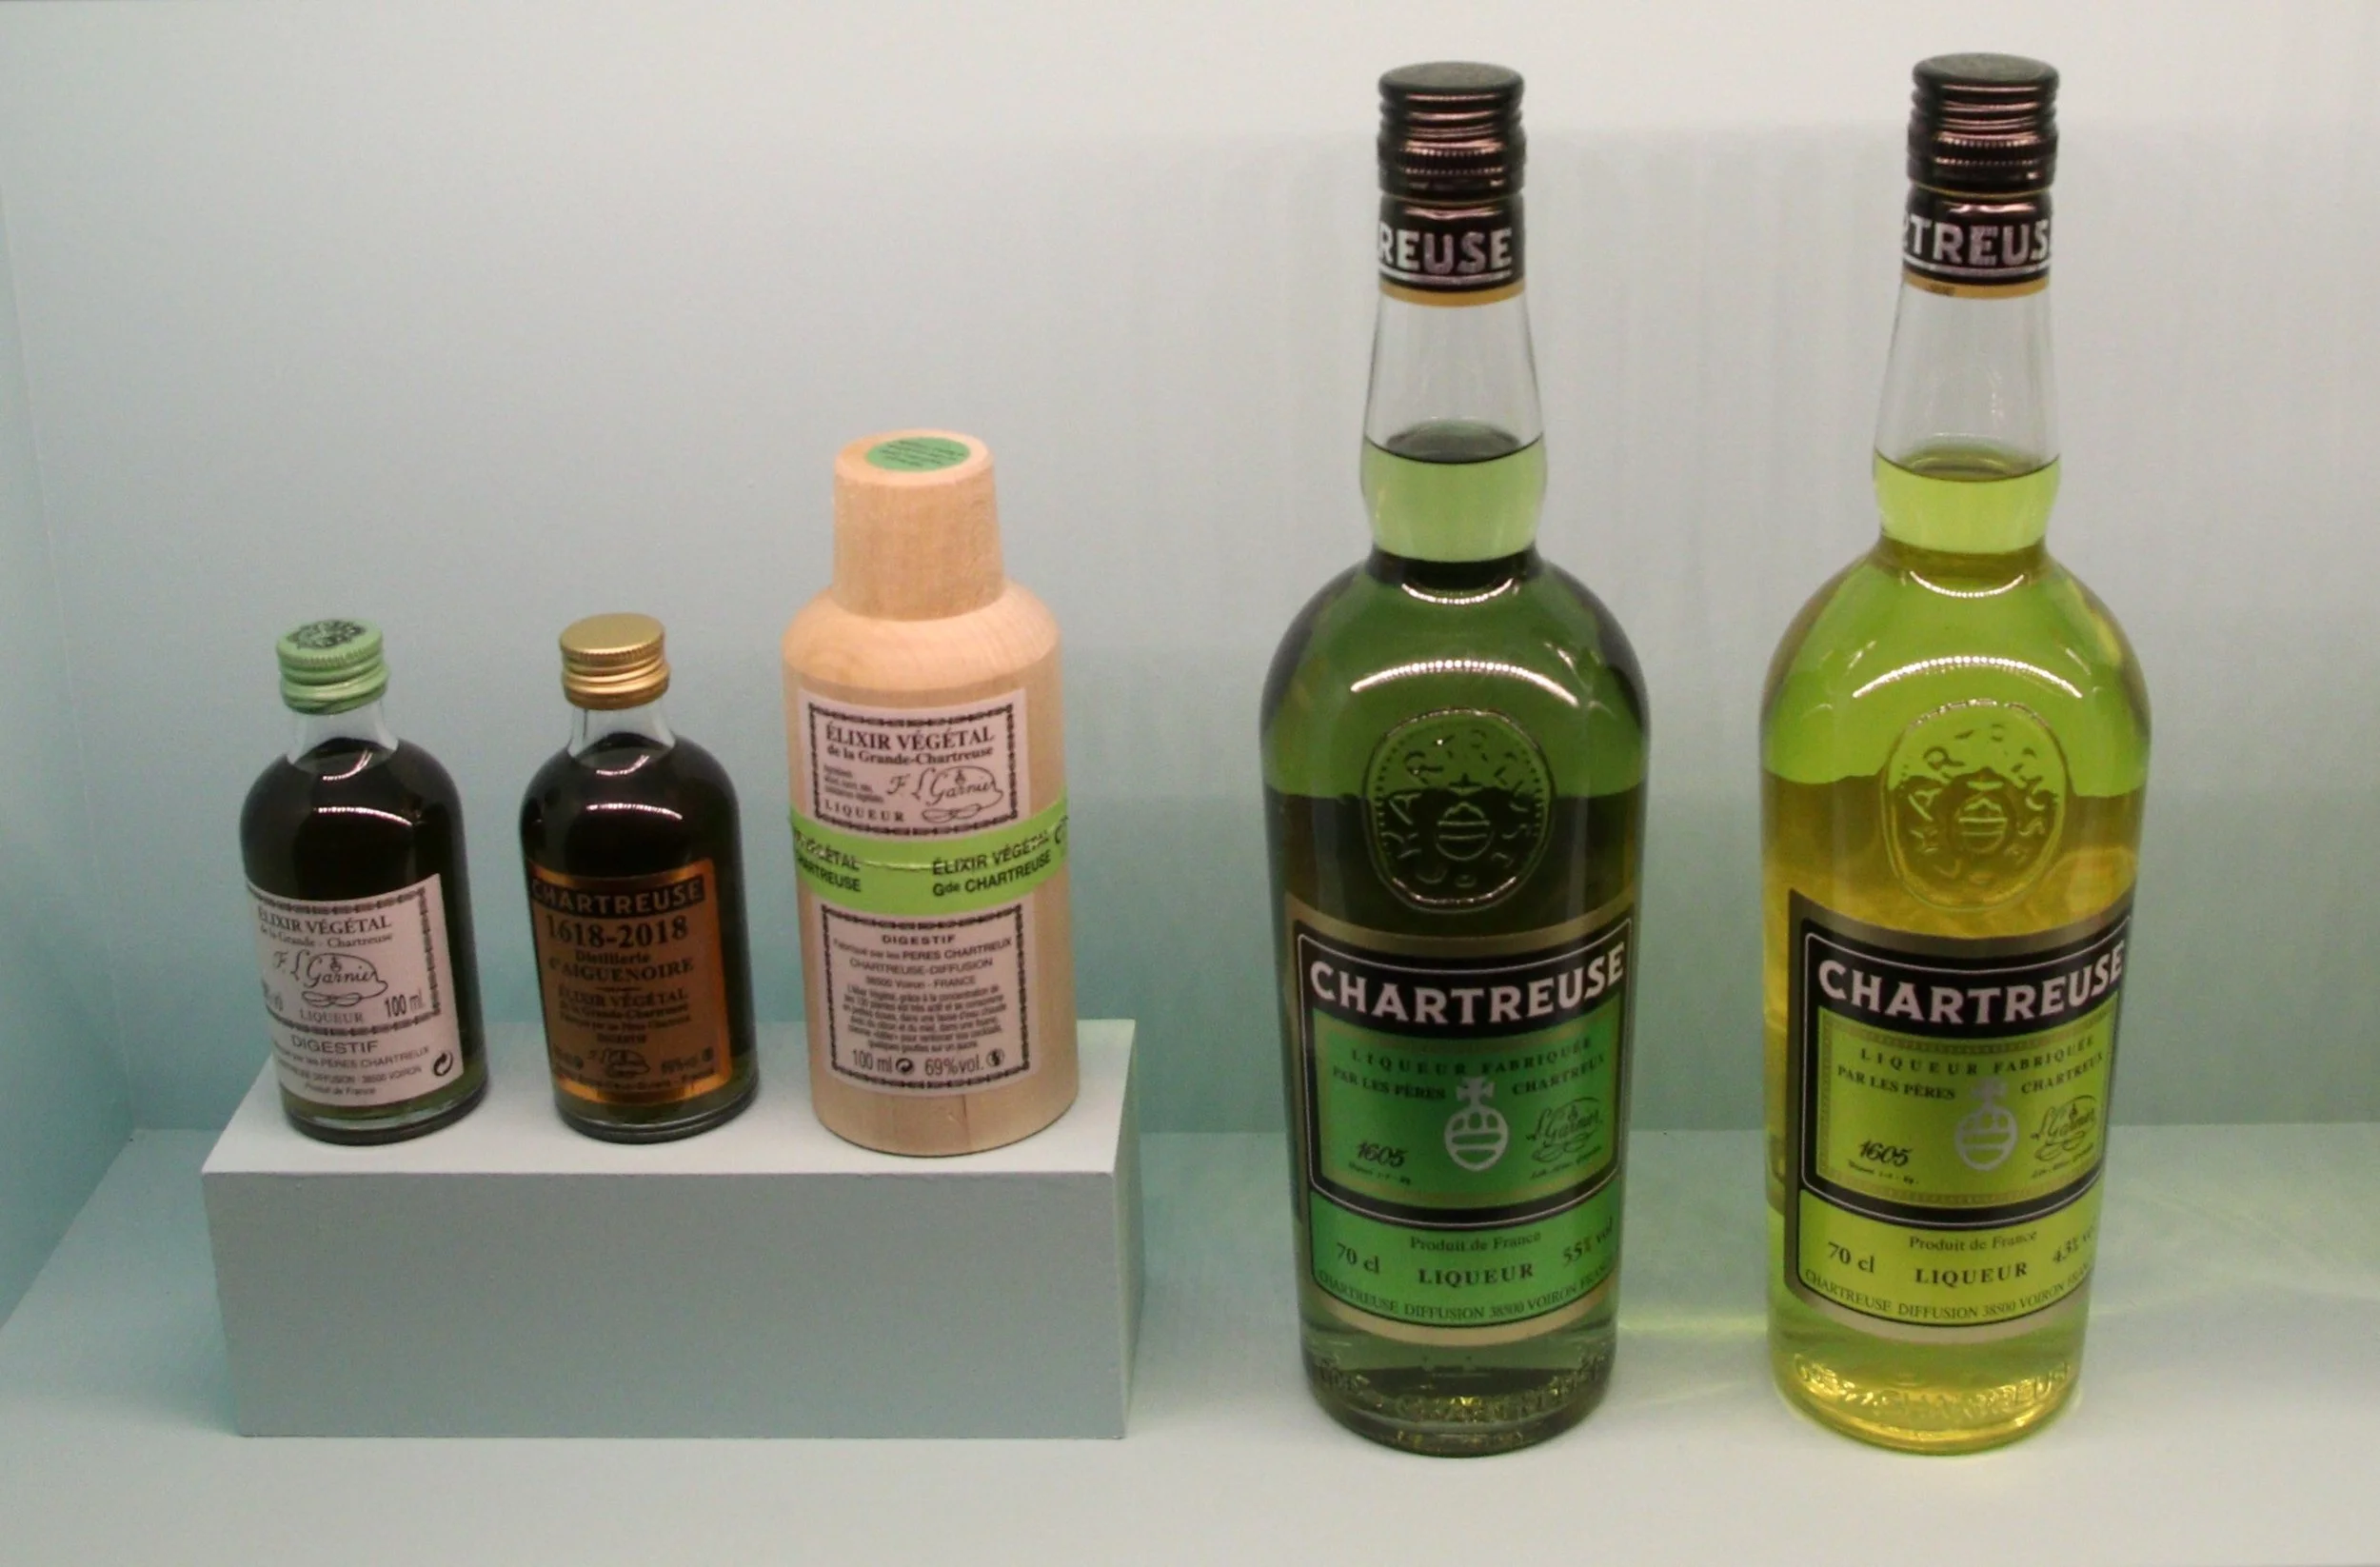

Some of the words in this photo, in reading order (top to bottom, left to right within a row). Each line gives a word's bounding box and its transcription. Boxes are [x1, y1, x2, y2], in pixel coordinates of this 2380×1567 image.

[1380, 222, 1512, 274] REUSE
[825, 722, 891, 750] ÉLIXIR
[897, 724, 995, 750] VÉGÉTAL
[827, 745, 841, 758] de
[843, 748, 855, 760] la
[824, 799, 903, 823] LIQUEUR
[933, 853, 987, 876] ÉLIXIR
[965, 849, 1052, 893] CHARTREUSE
[531, 878, 702, 914] CHARTREUSE
[306, 915, 392, 935] VÉGÉTAL
[545, 915, 688, 949] 1618-2018
[881, 934, 956, 945] DIGESTIF
[944, 938, 1012, 959] CHARTREUX
[1310, 942, 1624, 1025] CHARTREUSE
[1818, 940, 2125, 1025] CHARTREUSE
[299, 1008, 364, 1023] LIQUEUR
[384, 993, 407, 1018] 100
[291, 1033, 379, 1055] DIGESTIF
[853, 1049, 873, 1071] 100
[878, 1056, 893, 1074] ml
[1334, 1067, 1359, 1087] PAR
[1362, 1077, 1391, 1094] LES
[1512, 1053, 1606, 1096] CHARTREUX
[1352, 1050, 1466, 1076] LIQUEUR
[1861, 1048, 1978, 1076] LIQUEUR
[1838, 1066, 1866, 1086] PAR
[1870, 1076, 1898, 1094] LES
[1358, 1140, 1409, 1169] 1605
[1858, 1139, 1913, 1168] 1605
[1410, 1235, 1465, 1254] Produit
[1470, 1238, 1488, 1252] de
[1493, 1230, 1541, 1251] France
[1909, 1232, 1965, 1253] Produit
[1969, 1236, 1988, 1251] de
[1992, 1229, 2038, 1249] France
[1336, 1241, 1358, 1266] 70
[1363, 1254, 1380, 1276] cl
[1828, 1240, 1852, 1265] 70
[1857, 1255, 1875, 1275] cl
[1418, 1263, 1534, 1288] LIQUEUR
[1914, 1261, 2028, 1288] LIQUEUR
[1319, 1269, 1398, 1316] CHARTREUSE
[1404, 1302, 1485, 1320] DIFFUSION
[1805, 1269, 1892, 1314] CHARTREUSE
[1898, 1302, 1978, 1320] DIFFUSION
